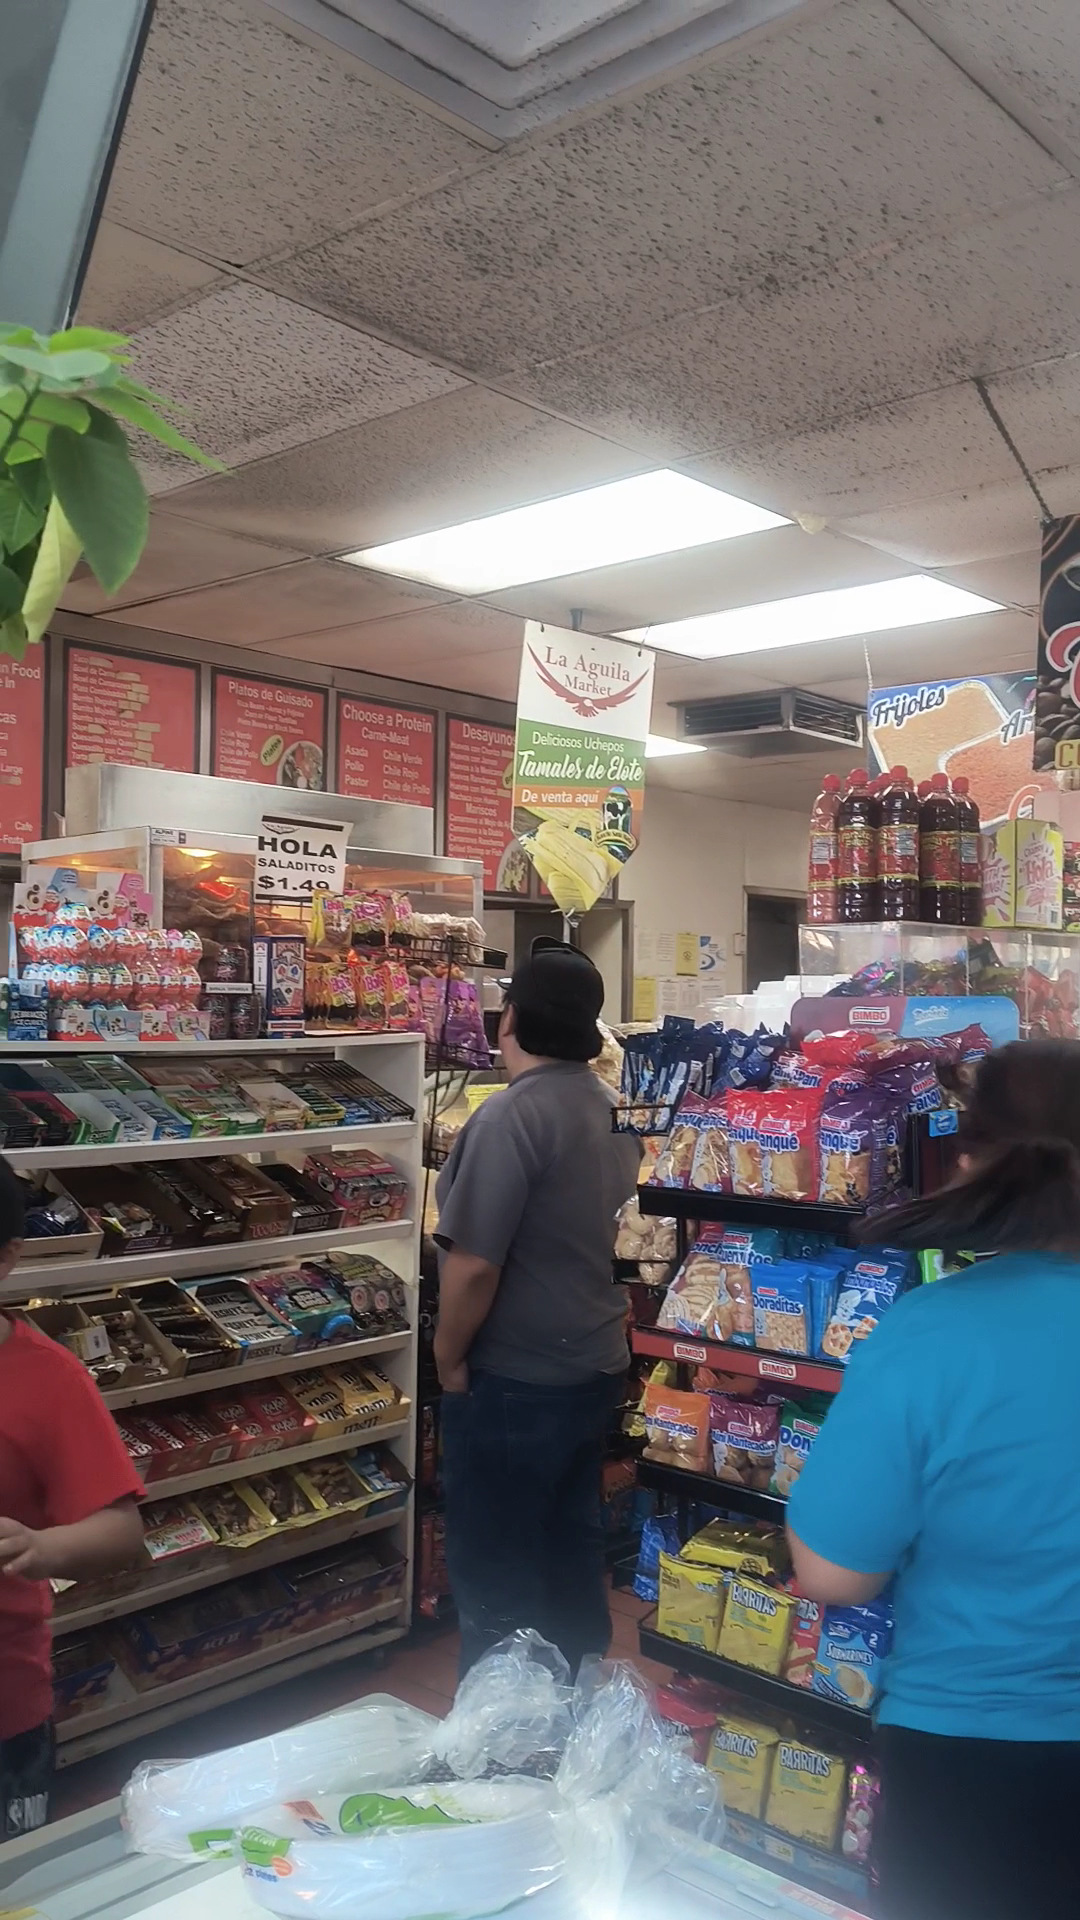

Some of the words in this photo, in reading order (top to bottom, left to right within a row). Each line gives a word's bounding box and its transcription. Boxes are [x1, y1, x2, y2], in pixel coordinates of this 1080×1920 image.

[12, 663, 41, 679] Food
[546, 646, 568, 668] La
[573, 654, 630, 682] Aguila
[228, 681, 259, 698] Platos
[261, 688, 273, 701] de
[275, 690, 313, 708] Guisado
[564, 674, 613, 697] Market
[343, 703, 384, 725] Choose
[386, 715, 393, 727] a
[395, 713, 432, 733] Protein
[871, 686, 946, 729] Frijoles
[362, 726, 409, 746] Carne-Meat
[532, 731, 582, 748] Deliciosos
[584, 737, 624, 755] Uchepos
[345, 744, 369, 757] Asada
[383, 749, 402, 762] Chile
[402, 752, 423, 765] Verde
[345, 759, 365, 772] Pollo
[383, 764, 402, 777] Chile
[402, 767, 419, 780] Rojo
[518, 749, 585, 780] Tamales
[585, 755, 605, 780] de
[607, 756, 644, 782] Elote
[345, 774, 369, 787] Pastor
[383, 779, 401, 791] Chile
[402, 782, 411, 793] de
[412, 783, 430, 795] Pollo
[521, 789, 538, 803] De
[541, 792, 573, 803] venta
[575, 790, 600, 807] aquí
[466, 802, 497, 817] Mariscos
[258, 835, 338, 859] HOLA
[257, 857, 336, 874] SALADITOS
[257, 875, 330, 892] $1.49
[852, 1011, 888, 1021] BIMBO
[760, 1132, 799, 1152] anqué
[821, 1132, 860, 1151] anqué
[676, 1346, 704, 1360] BIMBO
[762, 1362, 794, 1377] BIMBO
[731, 1582, 777, 1617] BARRITAS
[869, 1633, 878, 1646] 2
[714, 1728, 759, 1760] BARRITAS
[779, 1745, 831, 1778] BARRITAS
